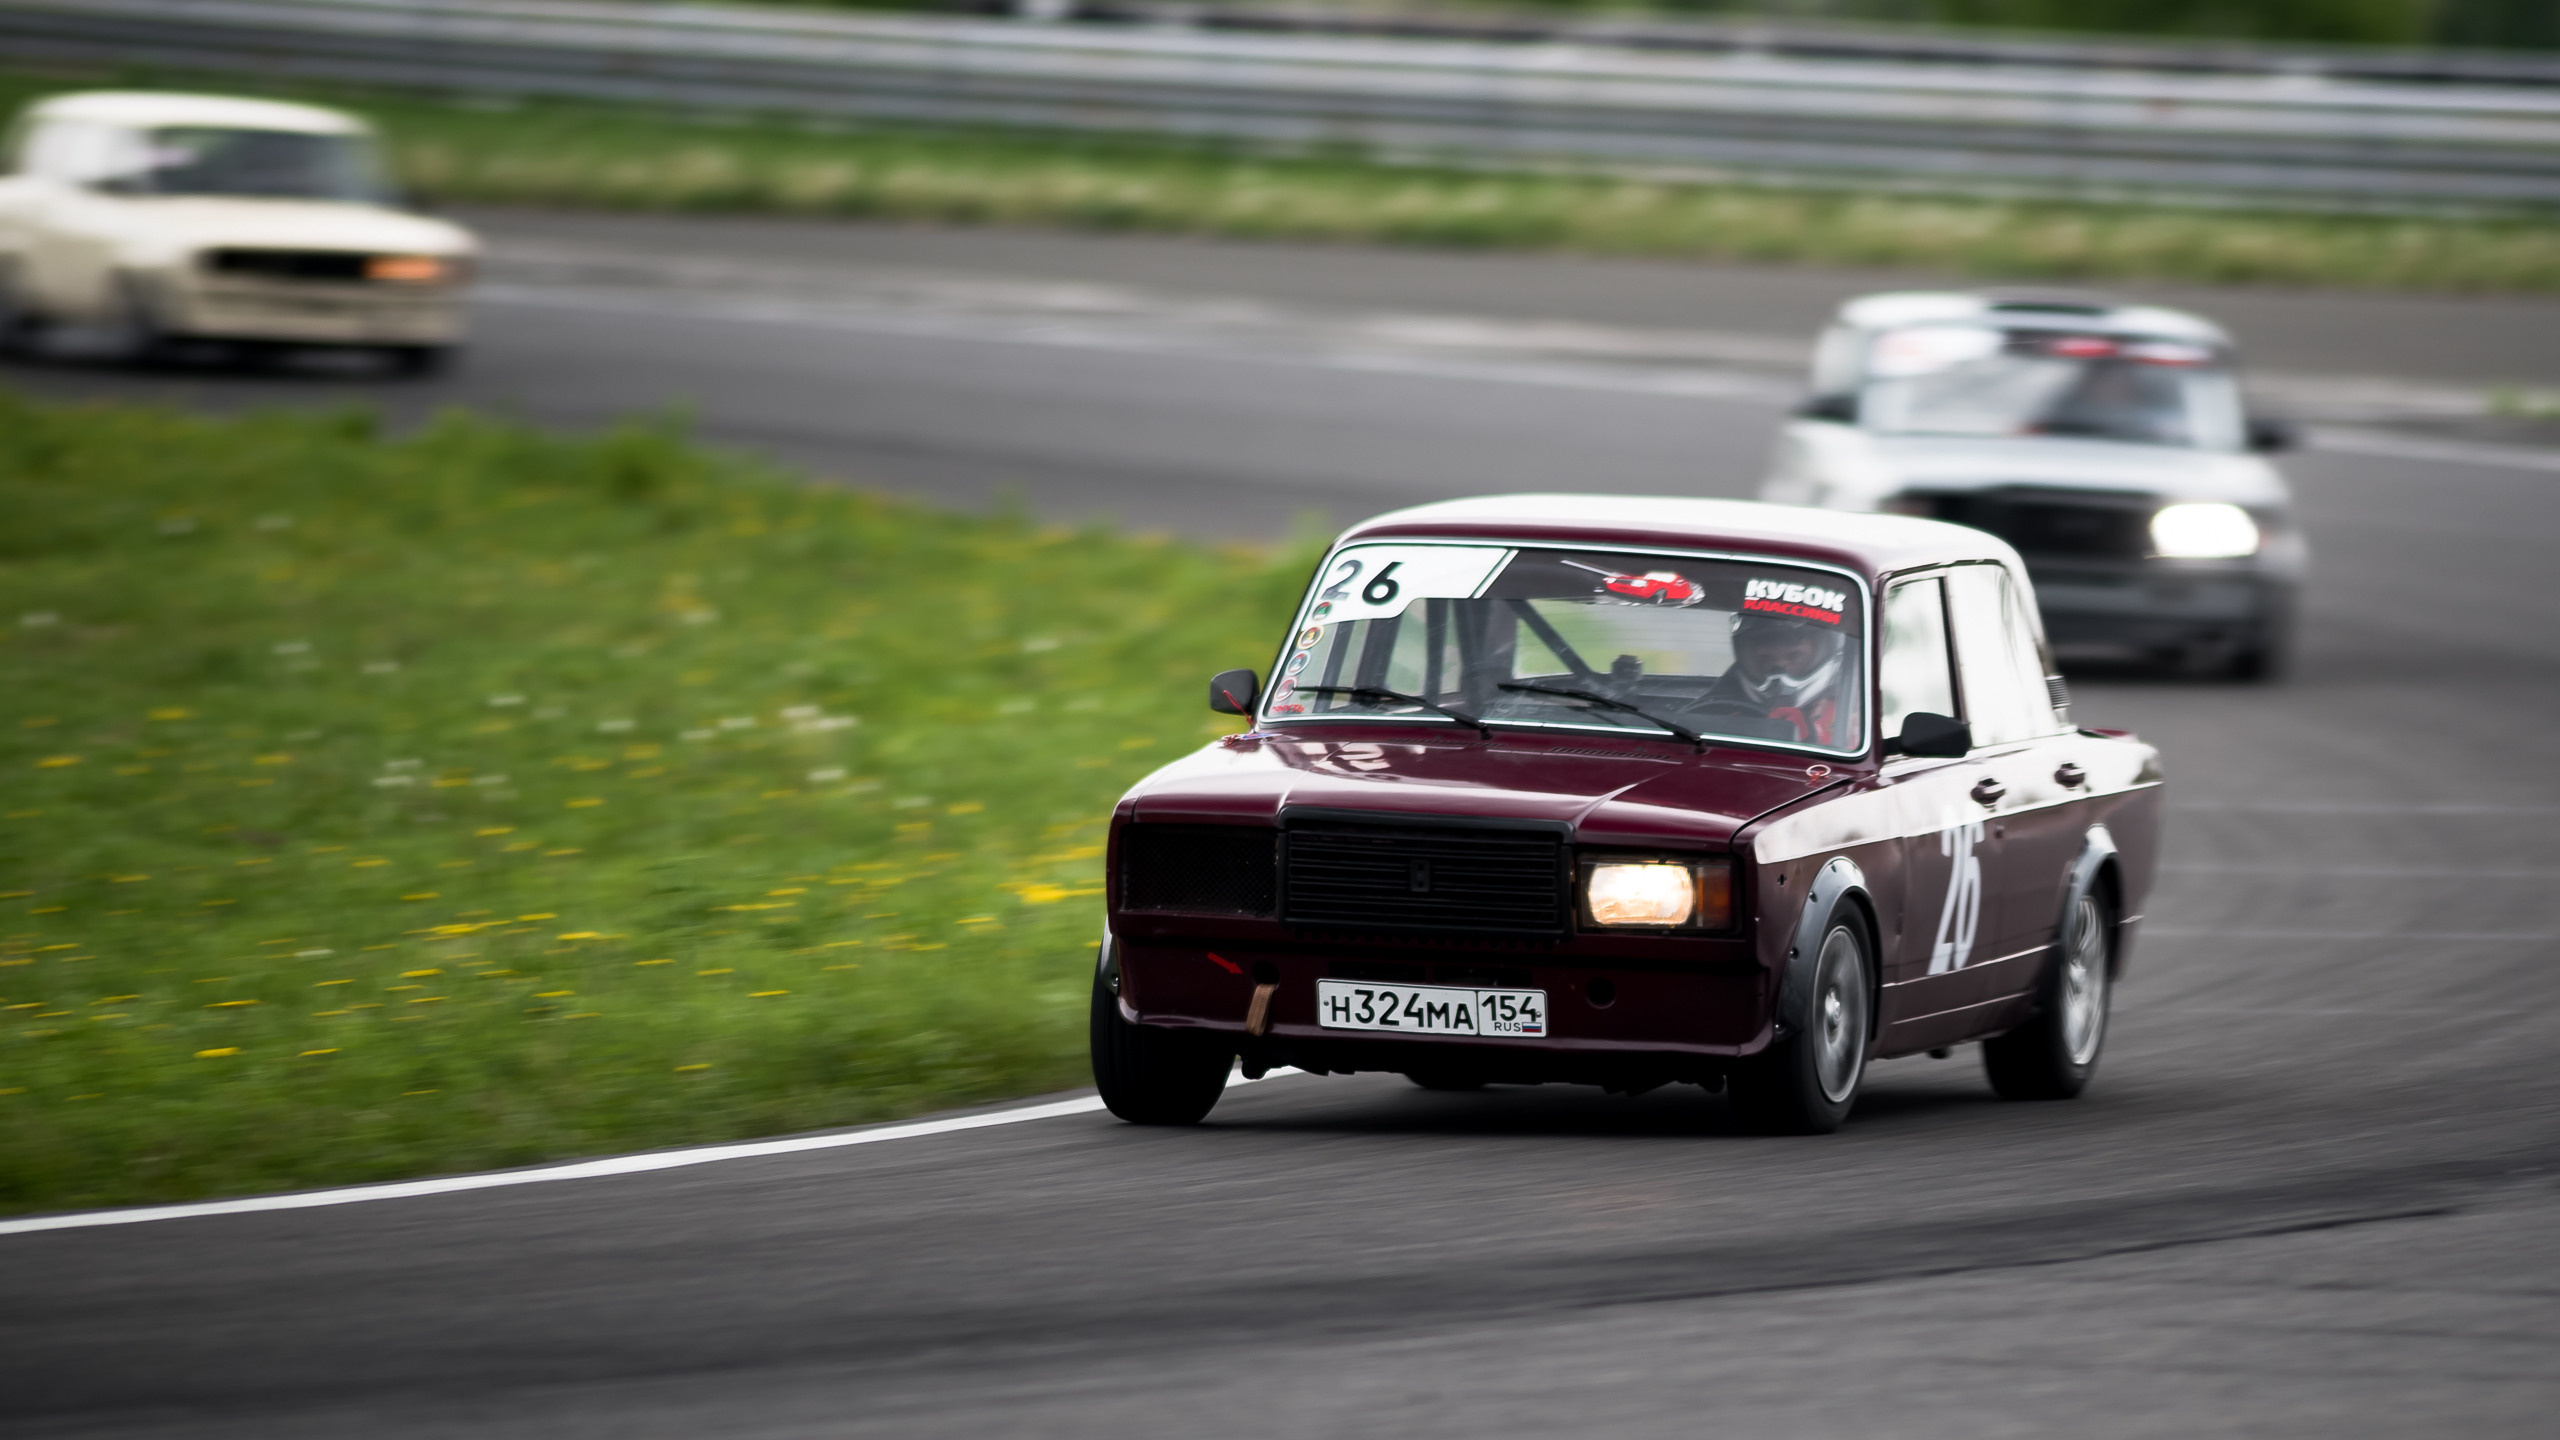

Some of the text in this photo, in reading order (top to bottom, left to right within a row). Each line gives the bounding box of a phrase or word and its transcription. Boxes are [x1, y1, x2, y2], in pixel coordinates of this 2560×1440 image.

[1320, 559, 1404, 605] 26
[1745, 579, 1846, 612] КУБОК
[1927, 821, 1985, 975] 26
[1481, 995, 1537, 1022] 154
[1494, 1021, 1521, 1032] RUS
